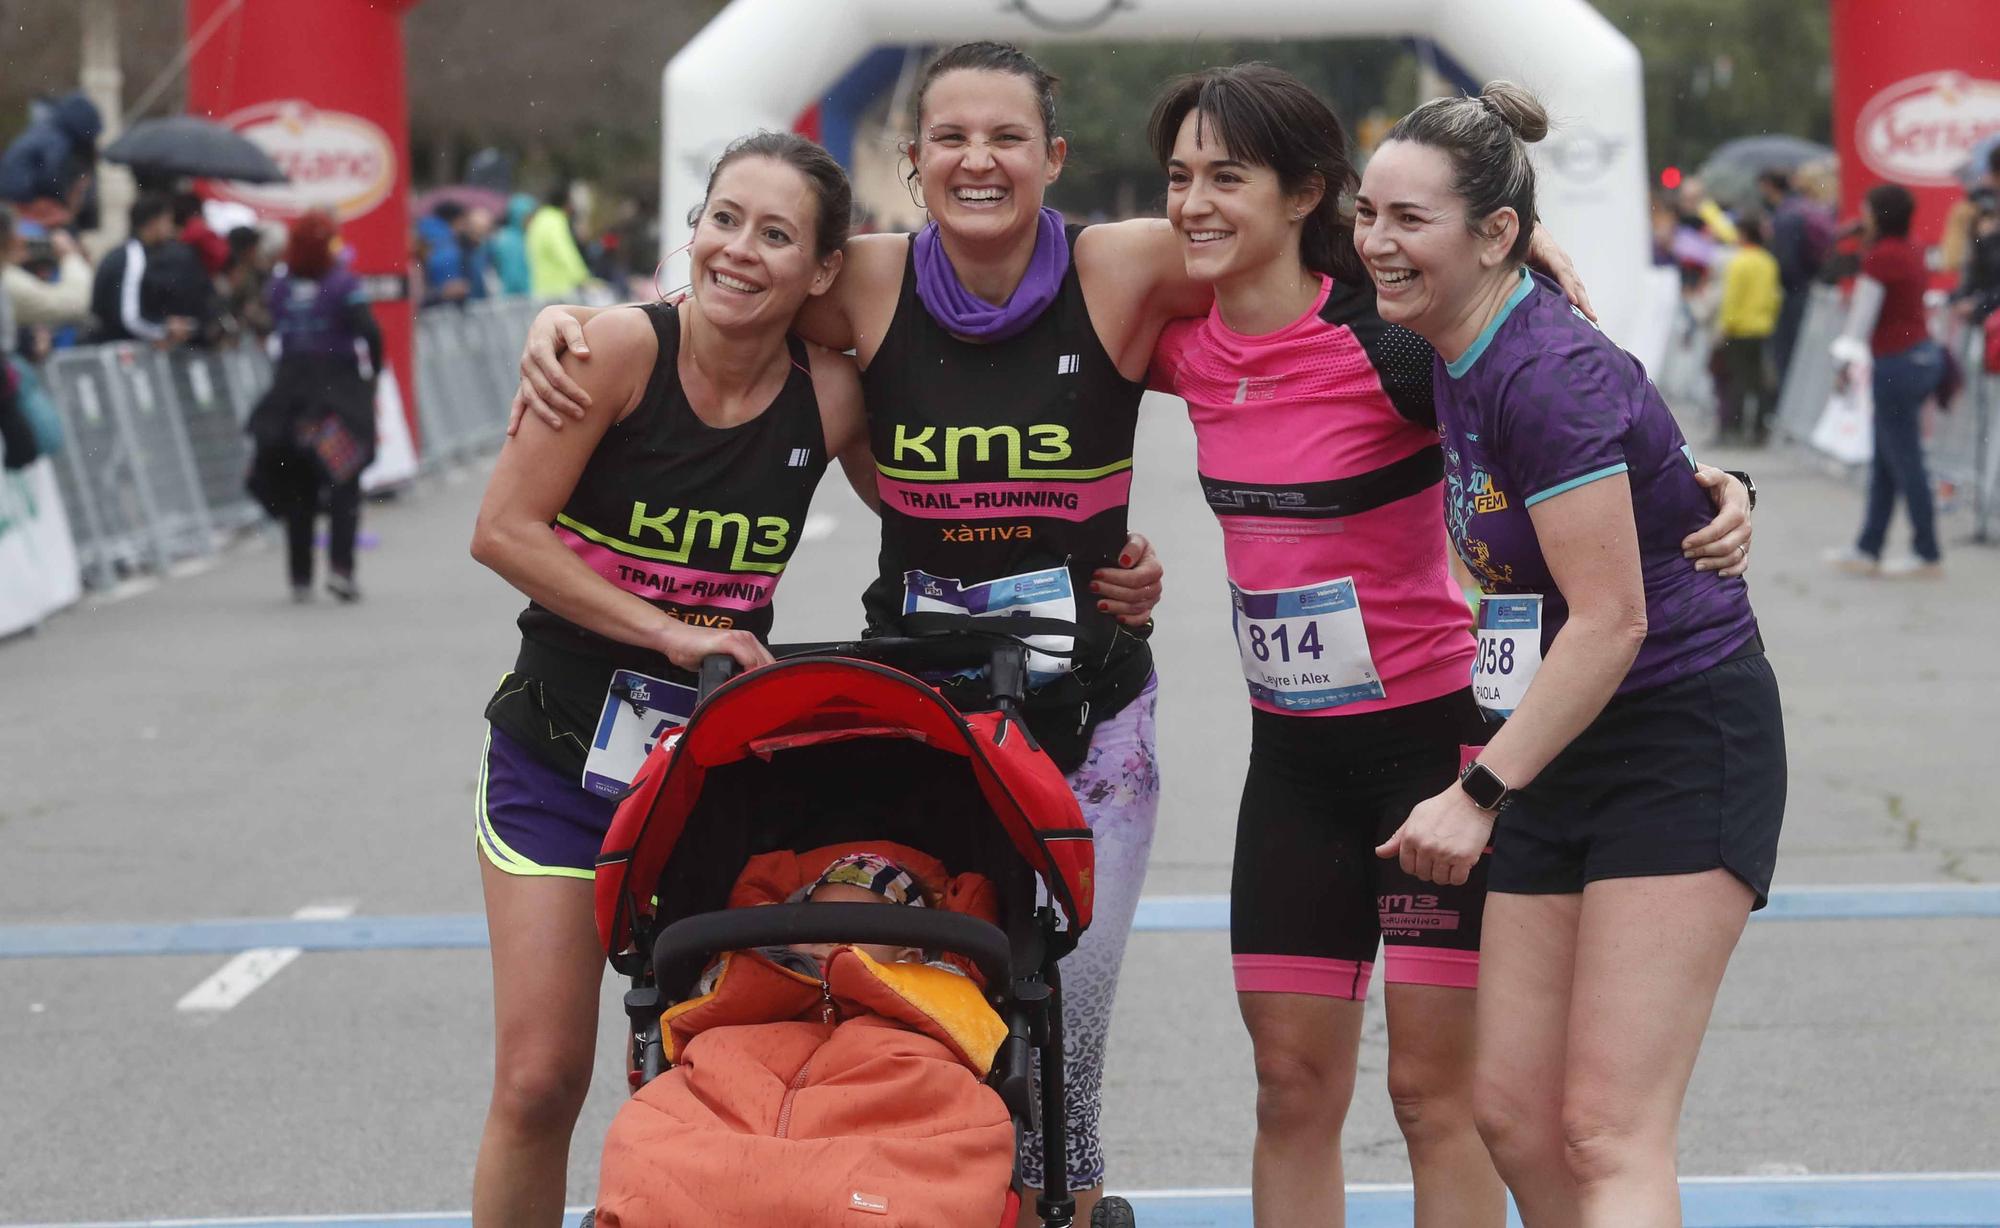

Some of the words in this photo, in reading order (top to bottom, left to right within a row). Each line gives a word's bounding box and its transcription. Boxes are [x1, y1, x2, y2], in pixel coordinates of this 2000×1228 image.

[899, 490, 1079, 510] TRAIL-RUNNING
[1477, 495, 1505, 511] FEM
[617, 564, 768, 603] TRAIL-RUNNIN
[926, 587, 942, 596] FEM
[1249, 621, 1324, 662] 814
[1476, 637, 1515, 675] 058
[1262, 672, 1293, 687] Leyre
[1294, 674, 1298, 685] i
[1301, 672, 1330, 684] Alex
[632, 691, 649, 700] FEM
